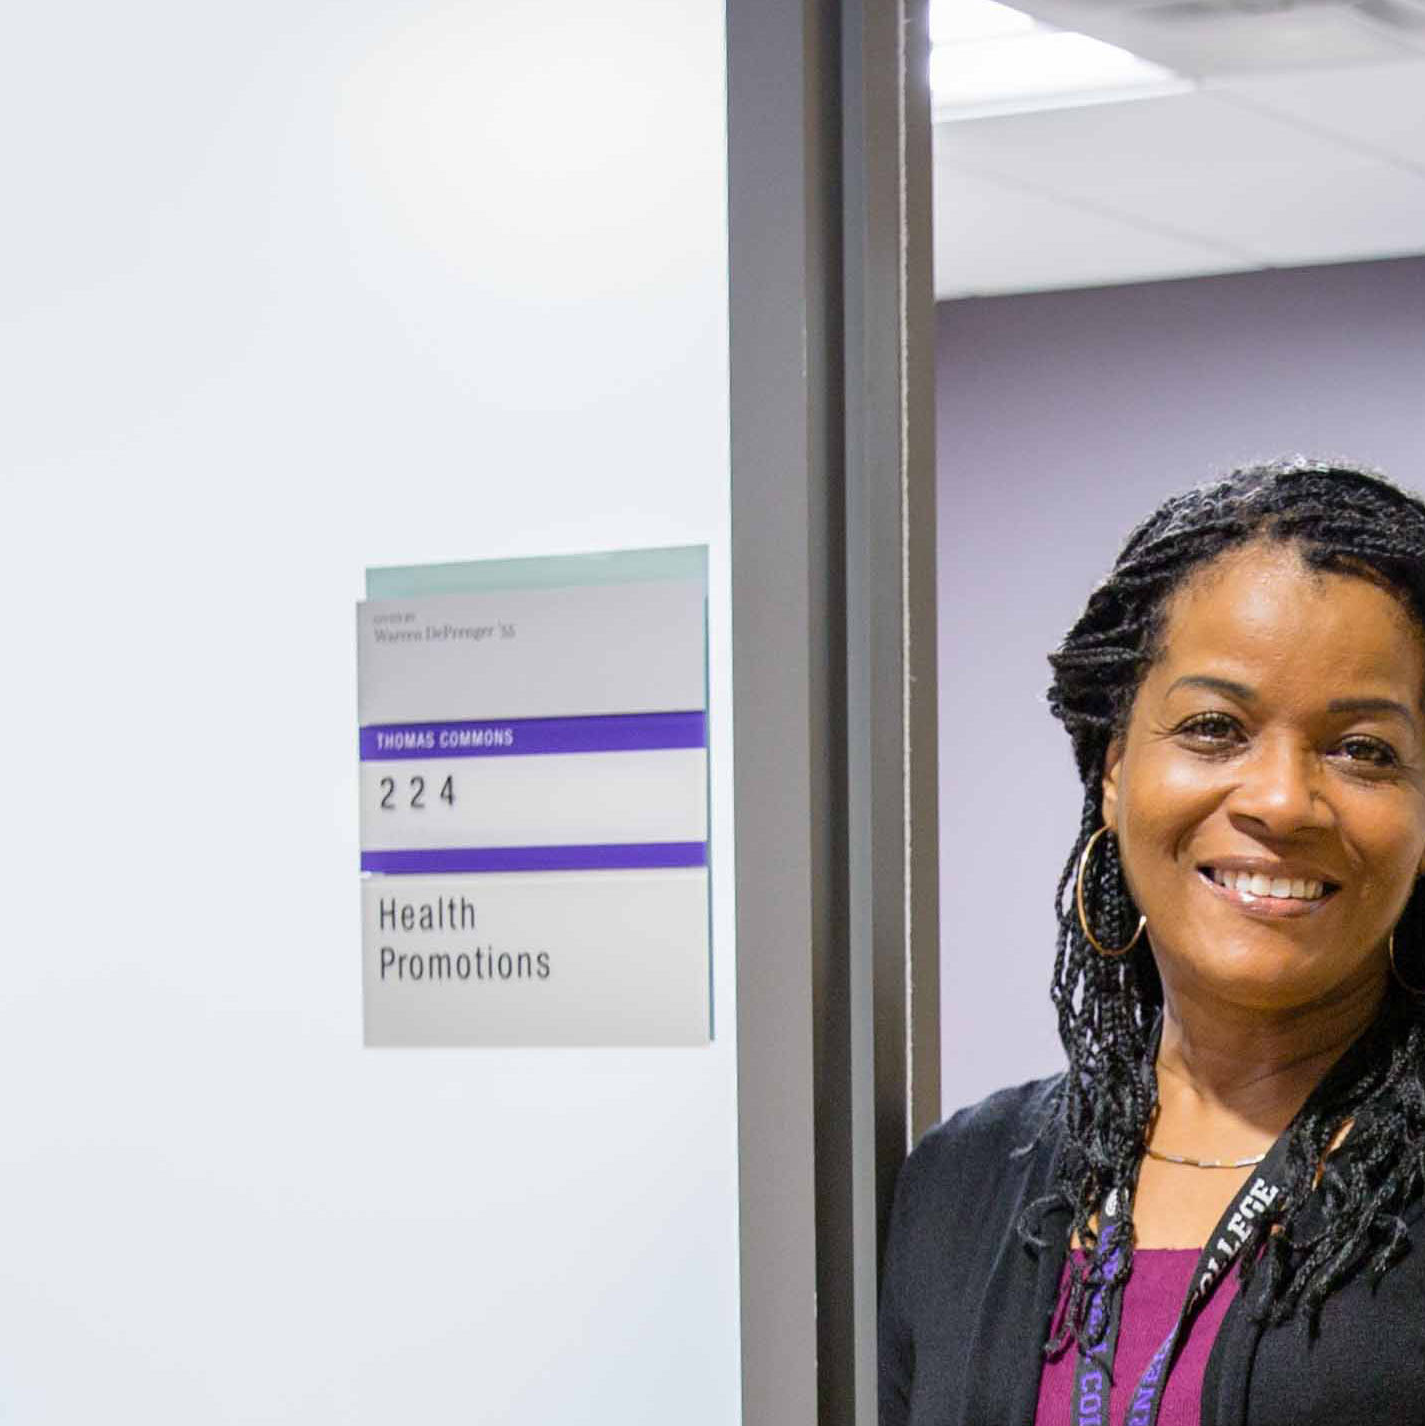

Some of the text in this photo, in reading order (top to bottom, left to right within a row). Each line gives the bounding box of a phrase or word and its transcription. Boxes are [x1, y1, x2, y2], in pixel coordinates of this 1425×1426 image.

[374, 627, 422, 642] Warren
[377, 728, 514, 750] THOMAS COMMONS
[379, 896, 475, 931] Health
[379, 945, 550, 981] Promotions
